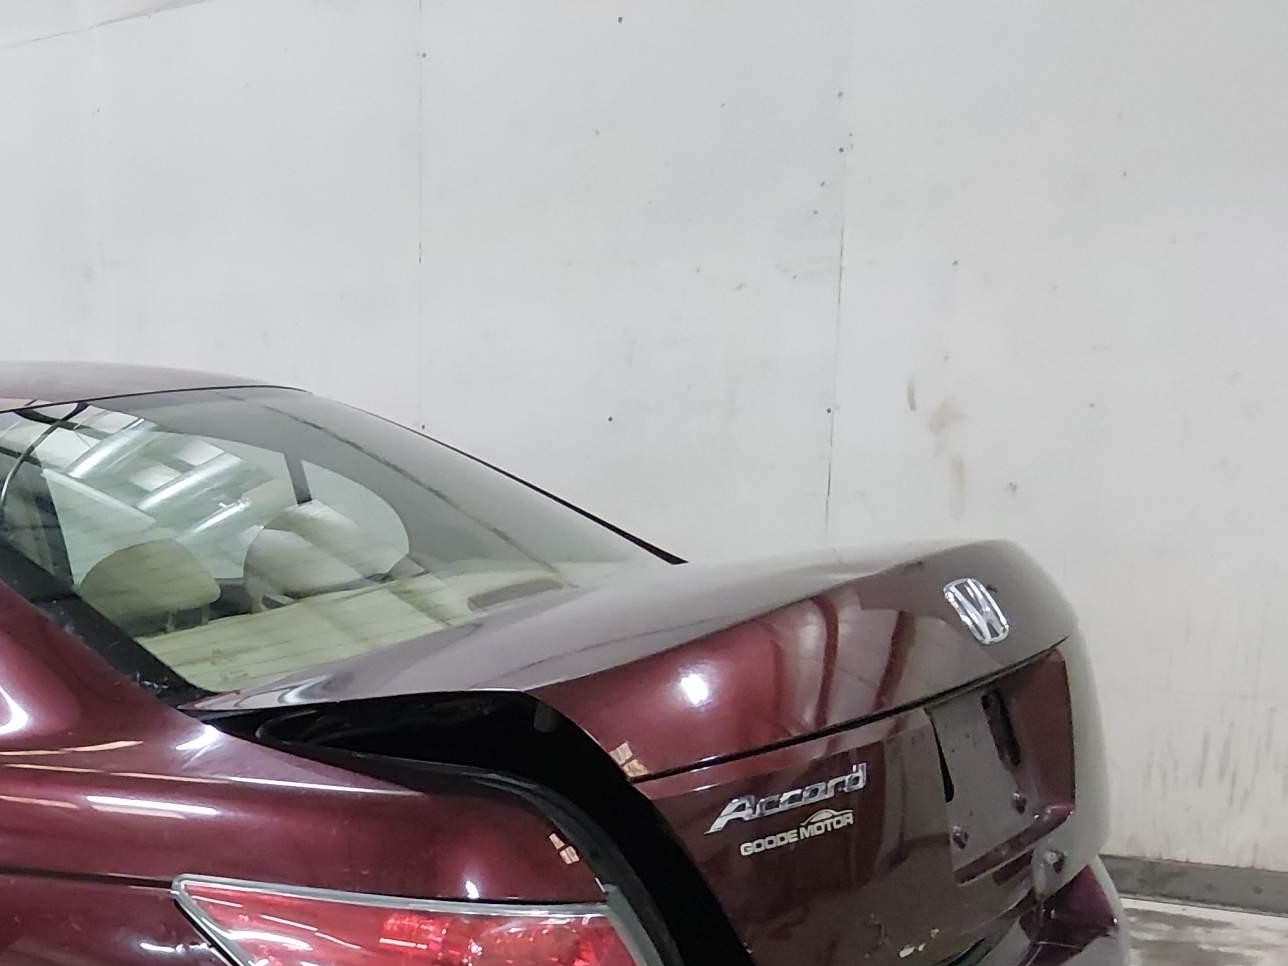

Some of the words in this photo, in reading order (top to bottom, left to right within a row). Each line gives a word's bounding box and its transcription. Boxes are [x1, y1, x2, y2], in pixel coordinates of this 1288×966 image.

[704, 762, 867, 835] Accord
[740, 829, 799, 857] GOODE
[799, 811, 854, 840] MOTOR
